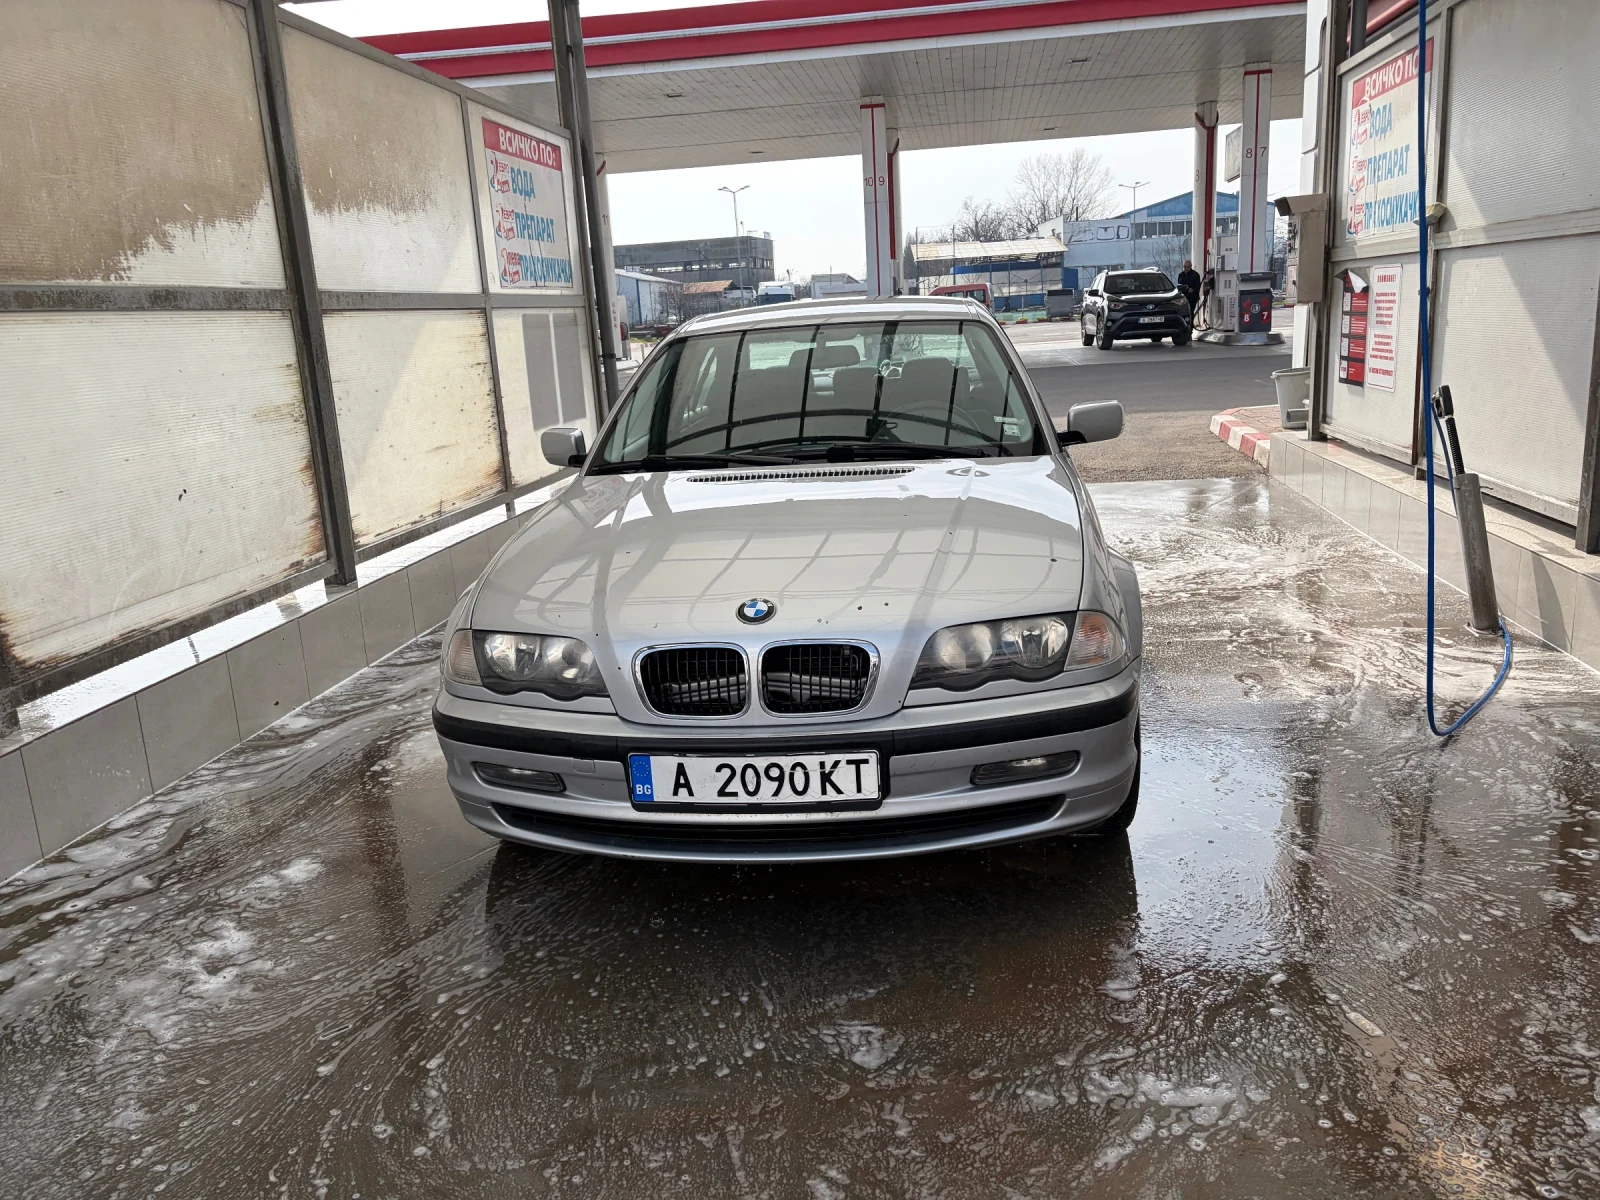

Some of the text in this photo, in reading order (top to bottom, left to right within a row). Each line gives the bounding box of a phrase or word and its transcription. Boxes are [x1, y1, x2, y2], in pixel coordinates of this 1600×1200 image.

[1365, 58, 1403, 97] ВСИЧКО
[1369, 102, 1393, 140] ВОДА
[499, 128, 556, 167] ВСИЧКО ПО:
[1245, 147, 1267, 158] 8 7
[1367, 144, 1409, 185] ПРЕПАРАТ
[510, 166, 536, 202] ВОДА
[864, 176, 885, 187] 10 9
[515, 211, 555, 243] ПРЕПАРАТ
[1243, 313, 1250, 323] 8
[1262, 311, 1268, 320] 7
[636, 784, 651, 795] BG
[672, 762, 694, 797] A
